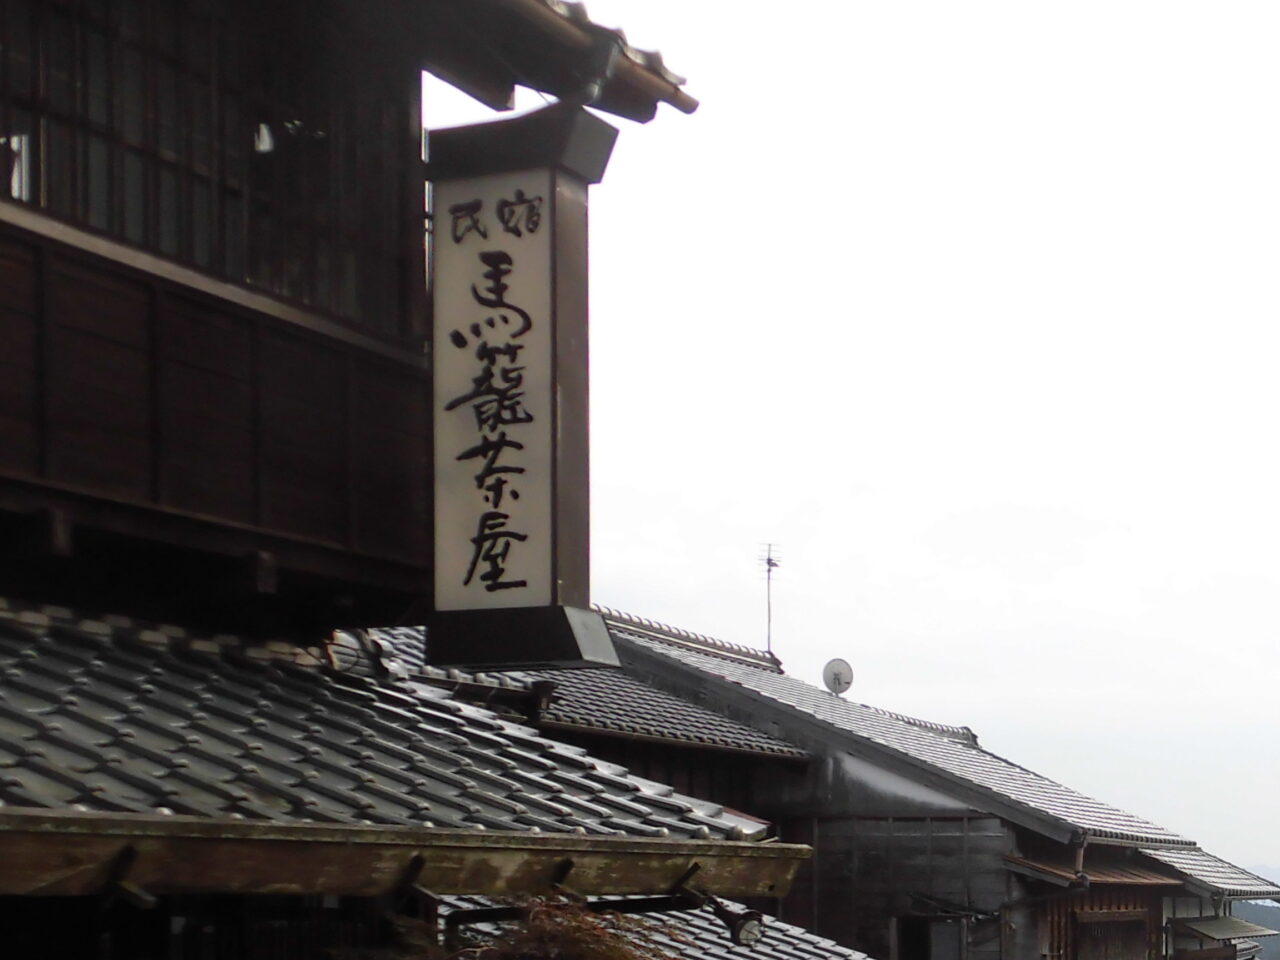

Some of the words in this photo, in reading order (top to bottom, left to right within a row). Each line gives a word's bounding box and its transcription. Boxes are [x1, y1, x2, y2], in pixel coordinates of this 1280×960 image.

[448, 190, 543, 245] 民宿
[443, 251, 534, 592] 馬籠茶屋
